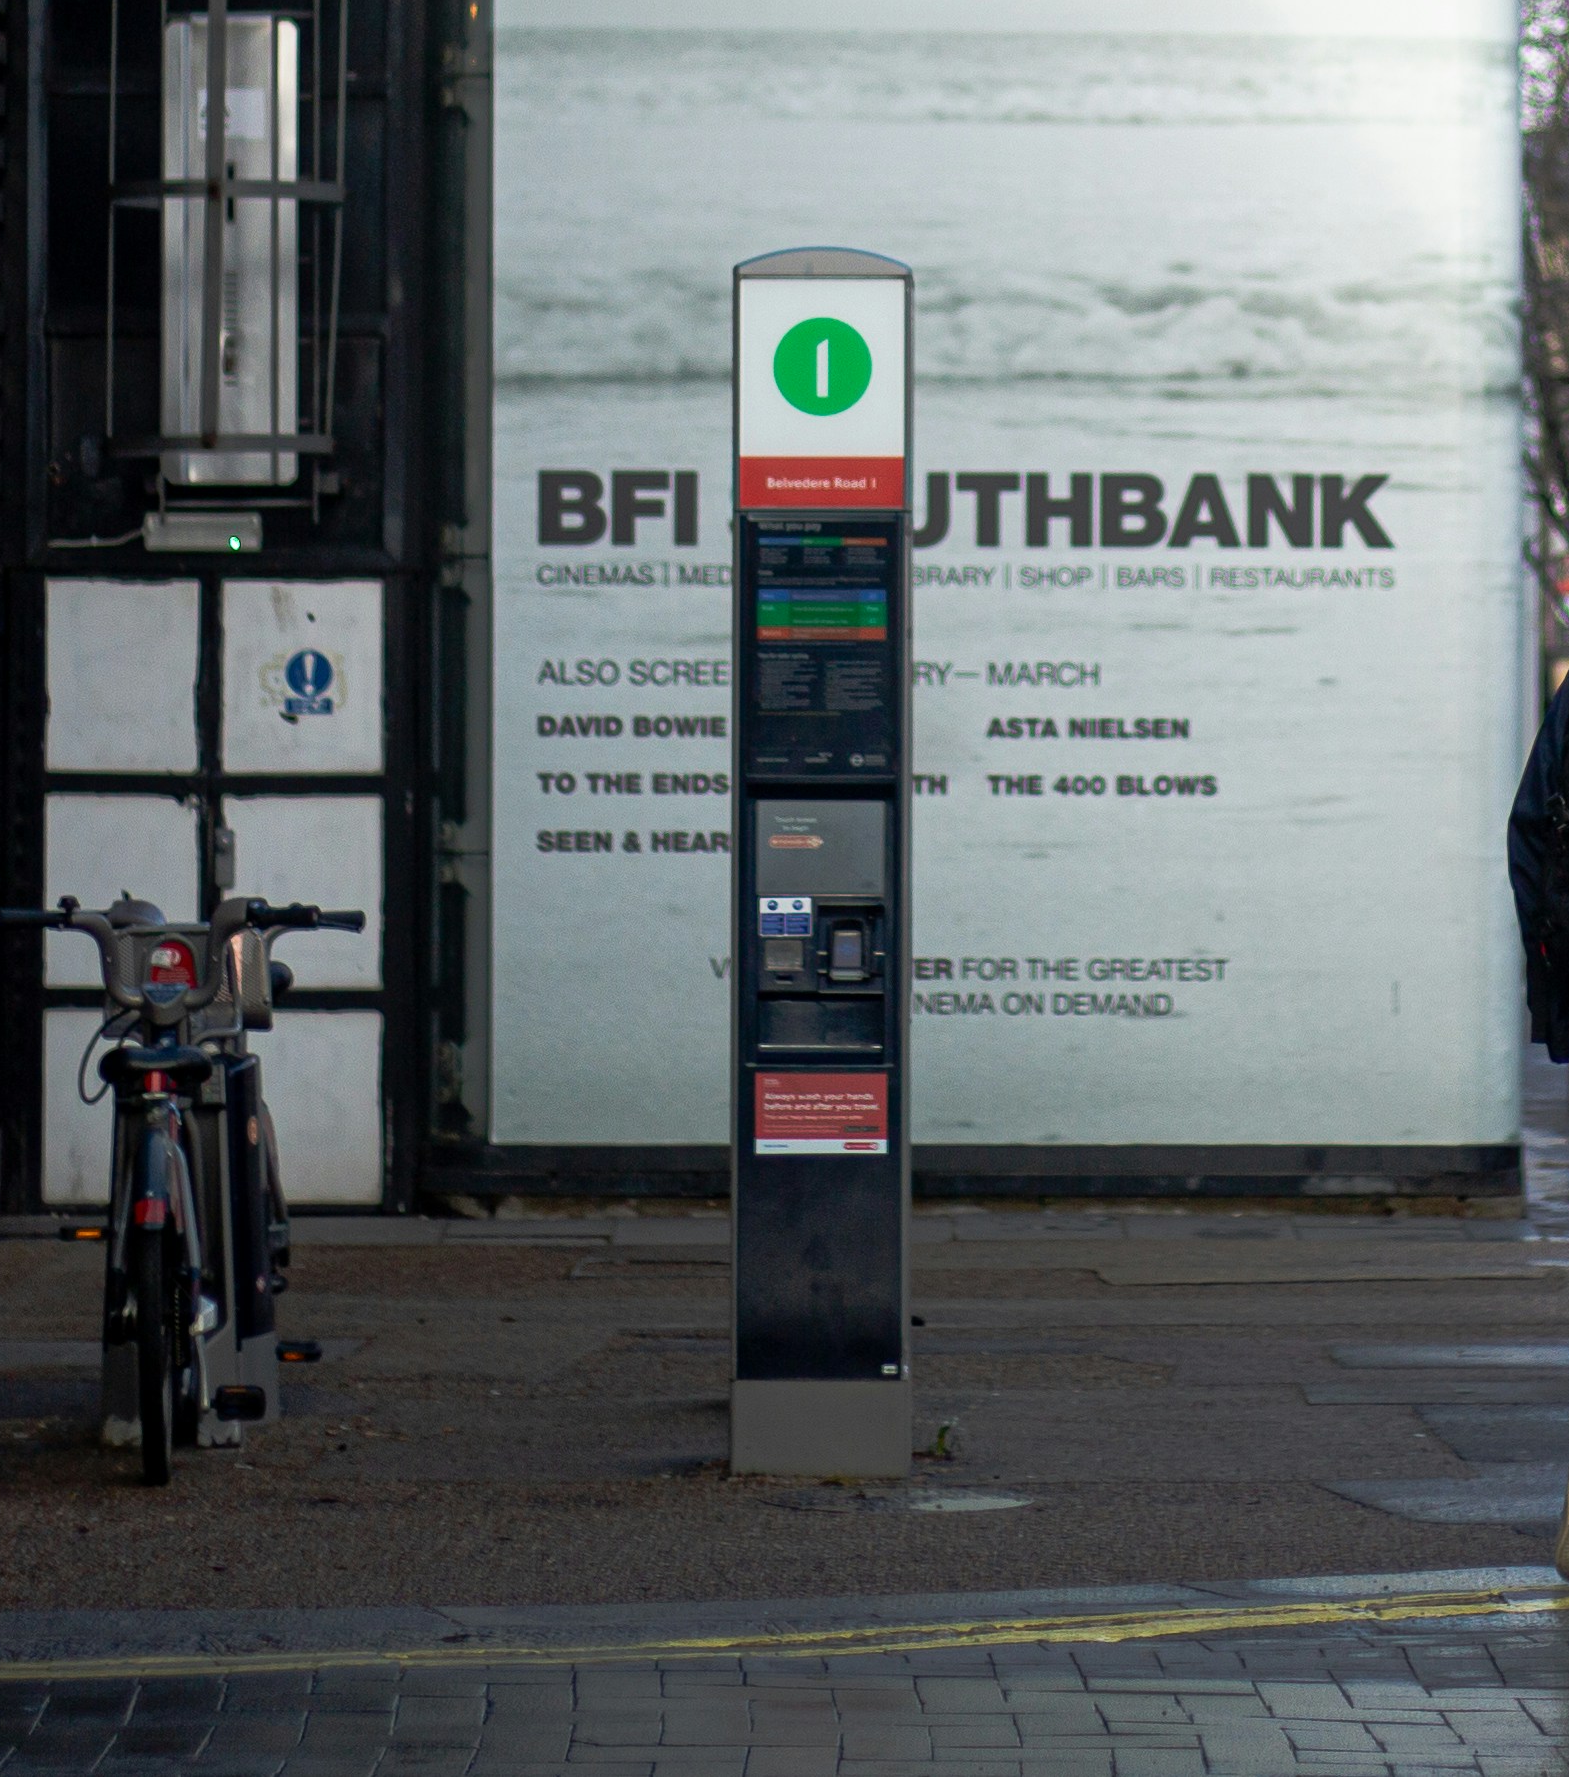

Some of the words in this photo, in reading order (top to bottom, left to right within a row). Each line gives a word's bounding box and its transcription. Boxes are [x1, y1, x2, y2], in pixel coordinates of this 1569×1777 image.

[767, 476, 831, 490] Belvedere
[834, 476, 867, 490] Road
[538, 470, 699, 547] BFI
[913, 472, 1395, 549] UTHBANK
[537, 563, 654, 587] CINEMAS
[913, 565, 995, 588] BRARY
[1019, 566, 1092, 588] SHOP
[1117, 567, 1185, 589] BARS
[1211, 567, 1396, 590] RESTAURANTS
[538, 659, 621, 687] ALSO
[629, 659, 730, 687] SCREE
[986, 662, 1102, 687] MARCH
[537, 716, 624, 738] DAVID
[633, 716, 727, 738] BOWIE
[986, 718, 1060, 739] ASTA
[1069, 718, 1190, 739] NIELSEN
[537, 773, 577, 795] TO
[585, 773, 643, 795] THE
[652, 773, 730, 795] ENDS
[986, 774, 1043, 796] THE
[1053, 774, 1106, 796] 400
[1116, 775, 1218, 796] BLOWS
[537, 831, 613, 854] SEEN
[622, 831, 643, 853] &
[651, 831, 731, 853] HEAR
[960, 957, 1019, 981] FOR
[1030, 957, 1079, 981] THE
[1088, 957, 1229, 981] GREATEST
[914, 992, 995, 1015] NEMA
[1002, 992, 1045, 1015] ON
[1052, 993, 1175, 1016] DEMAND
